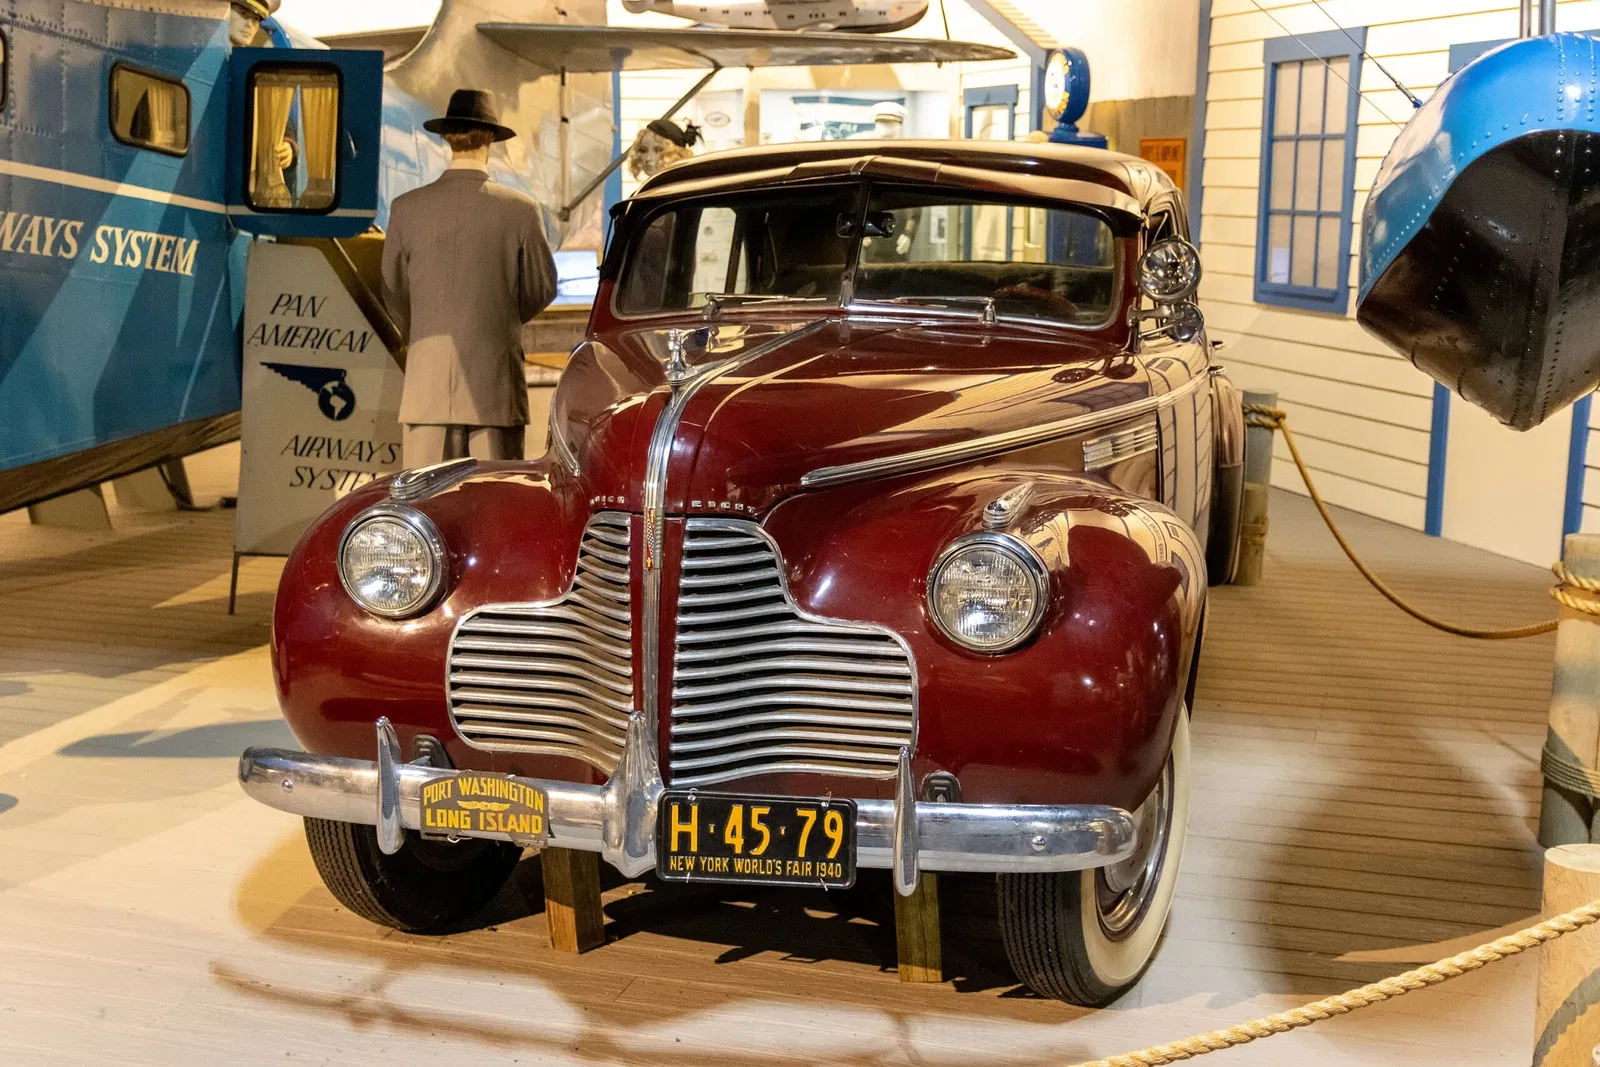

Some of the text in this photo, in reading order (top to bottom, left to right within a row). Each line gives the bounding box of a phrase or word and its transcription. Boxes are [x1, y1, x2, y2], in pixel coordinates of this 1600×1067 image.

[90, 224, 200, 276] SYSTEM
[270, 293, 328, 318] PAN
[247, 322, 374, 353] AMERICAN
[280, 434, 401, 465] AIRWAYS
[289, 465, 377, 492] SYSTE
[423, 776, 544, 814] PORT WASHINGTON
[425, 808, 543, 834] LONG ISLAND
[669, 855, 842, 878] NEW YORK WORLD'S FAIR 1940
